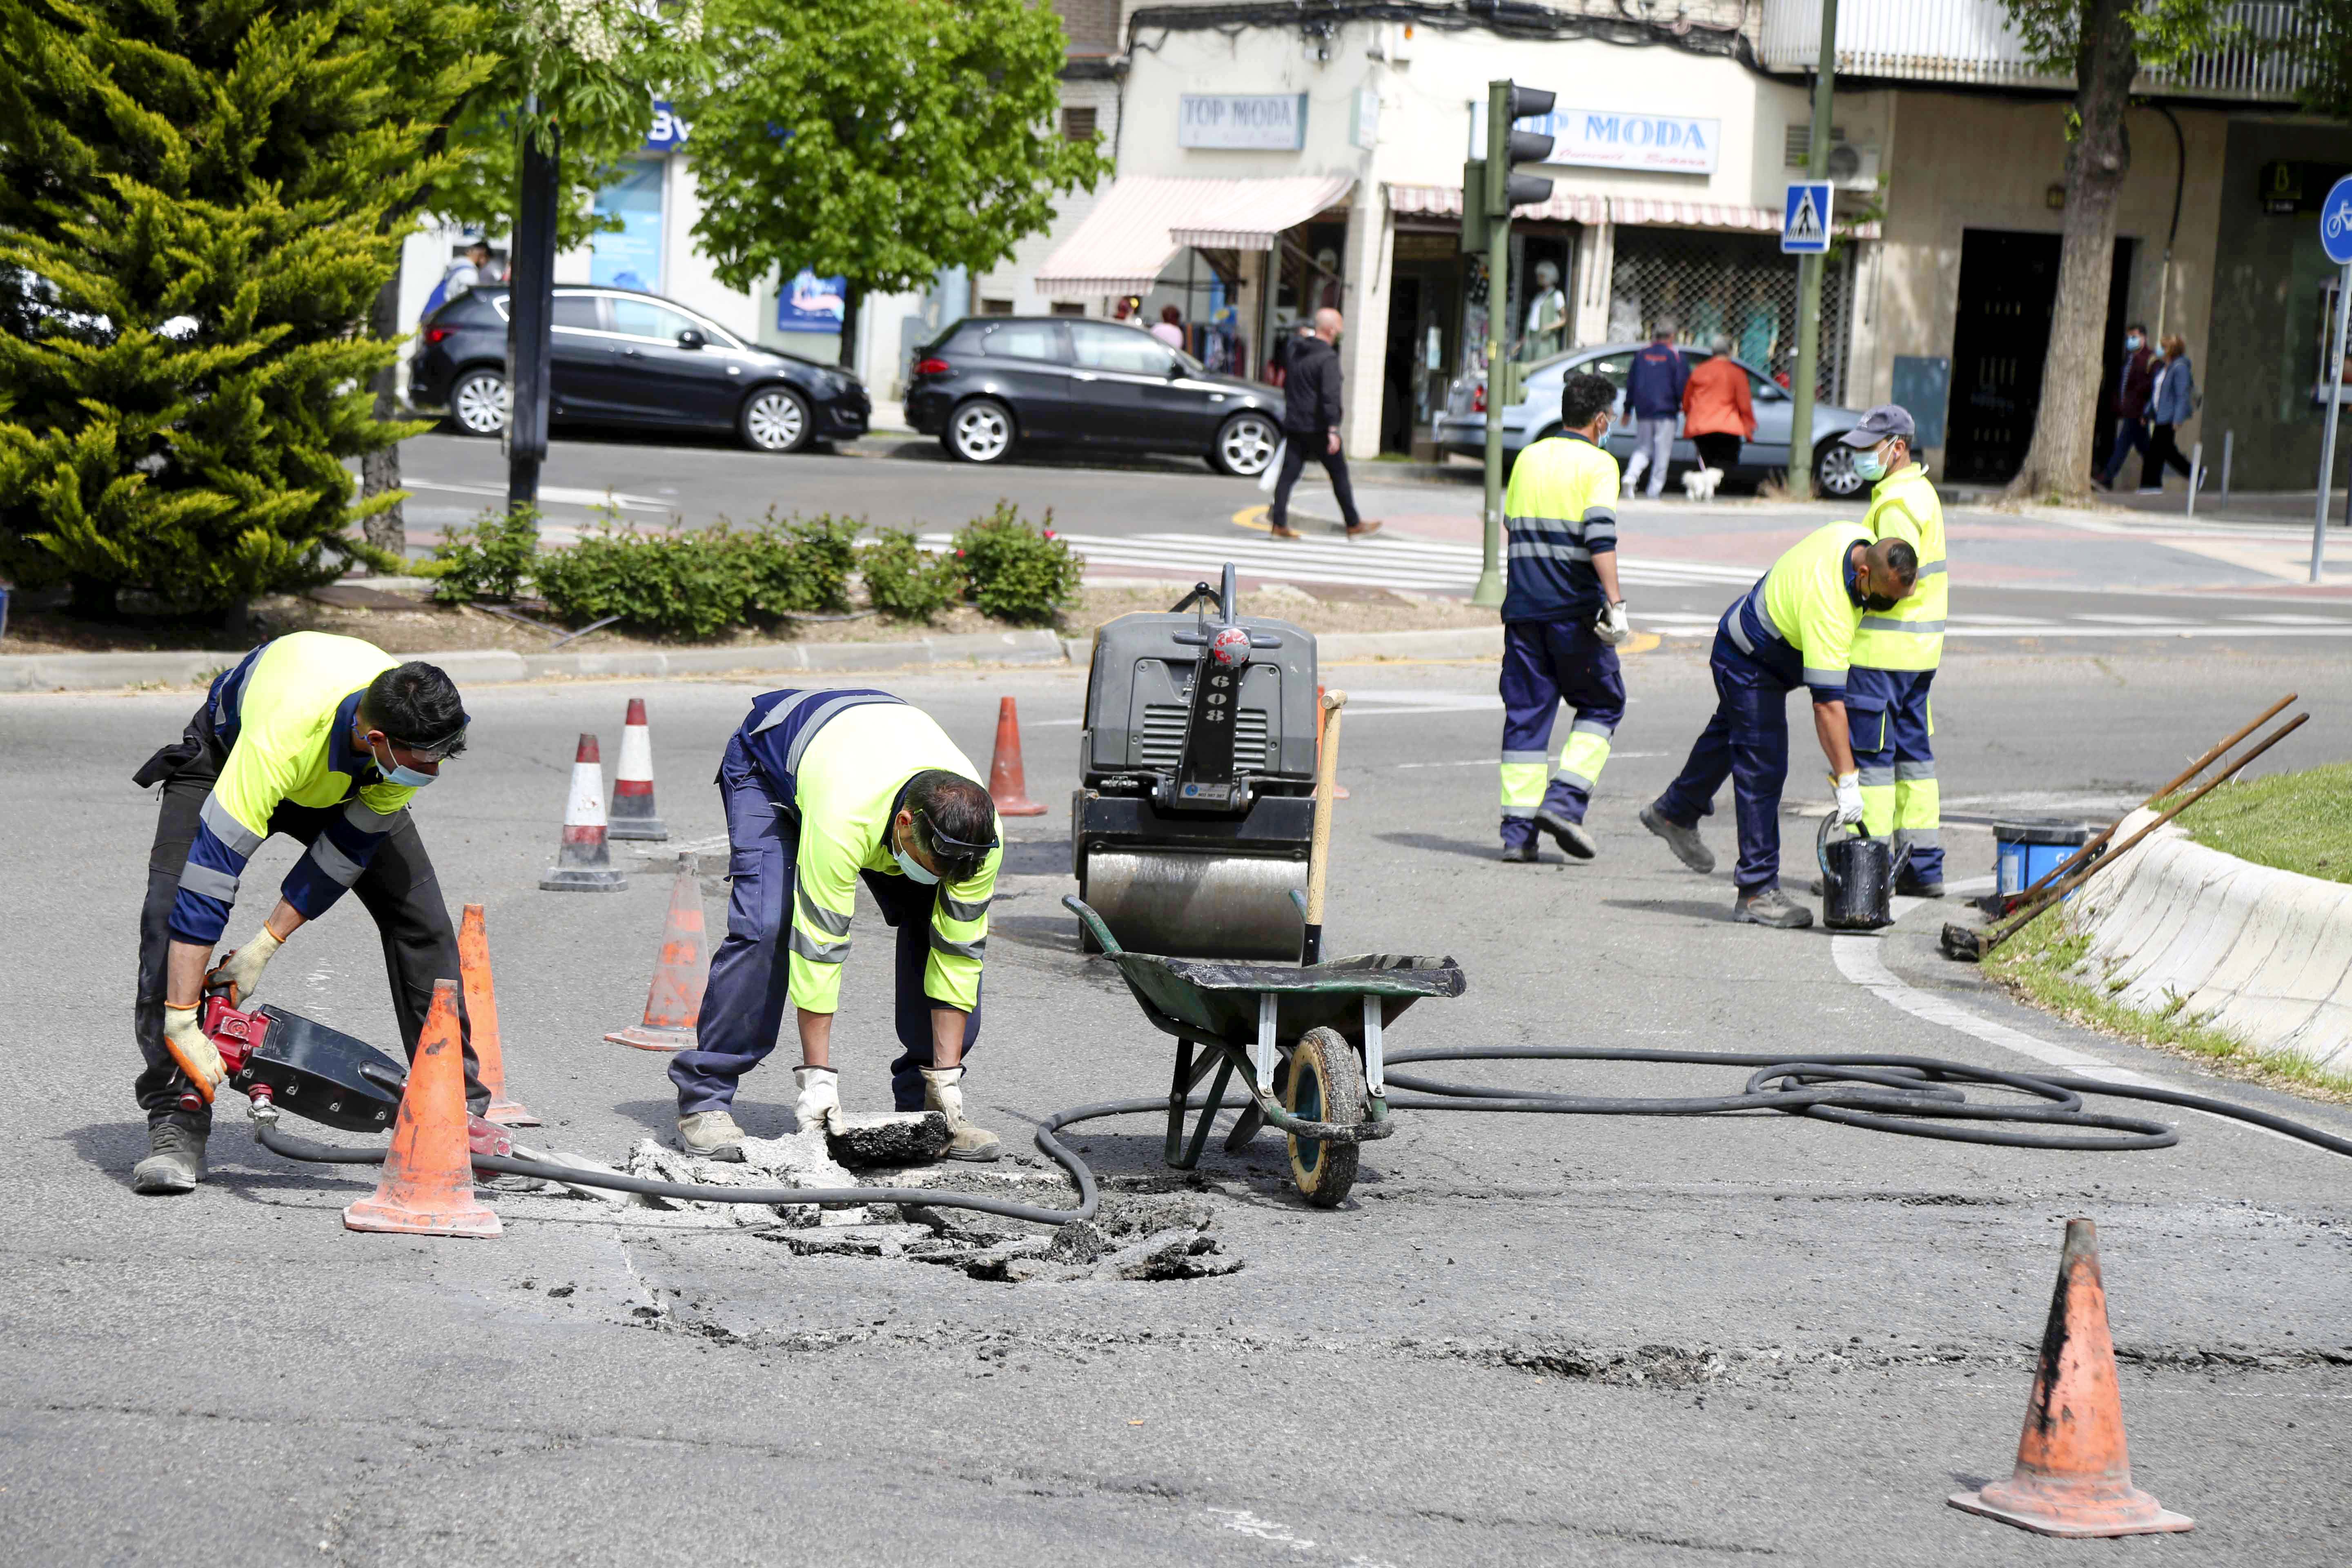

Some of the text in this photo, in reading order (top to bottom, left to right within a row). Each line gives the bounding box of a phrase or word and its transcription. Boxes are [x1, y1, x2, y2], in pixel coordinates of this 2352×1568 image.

[1185, 100, 1292, 127] TOP MODA
[1586, 115, 1706, 150] MODA
[1206, 676, 1230, 722] 608
